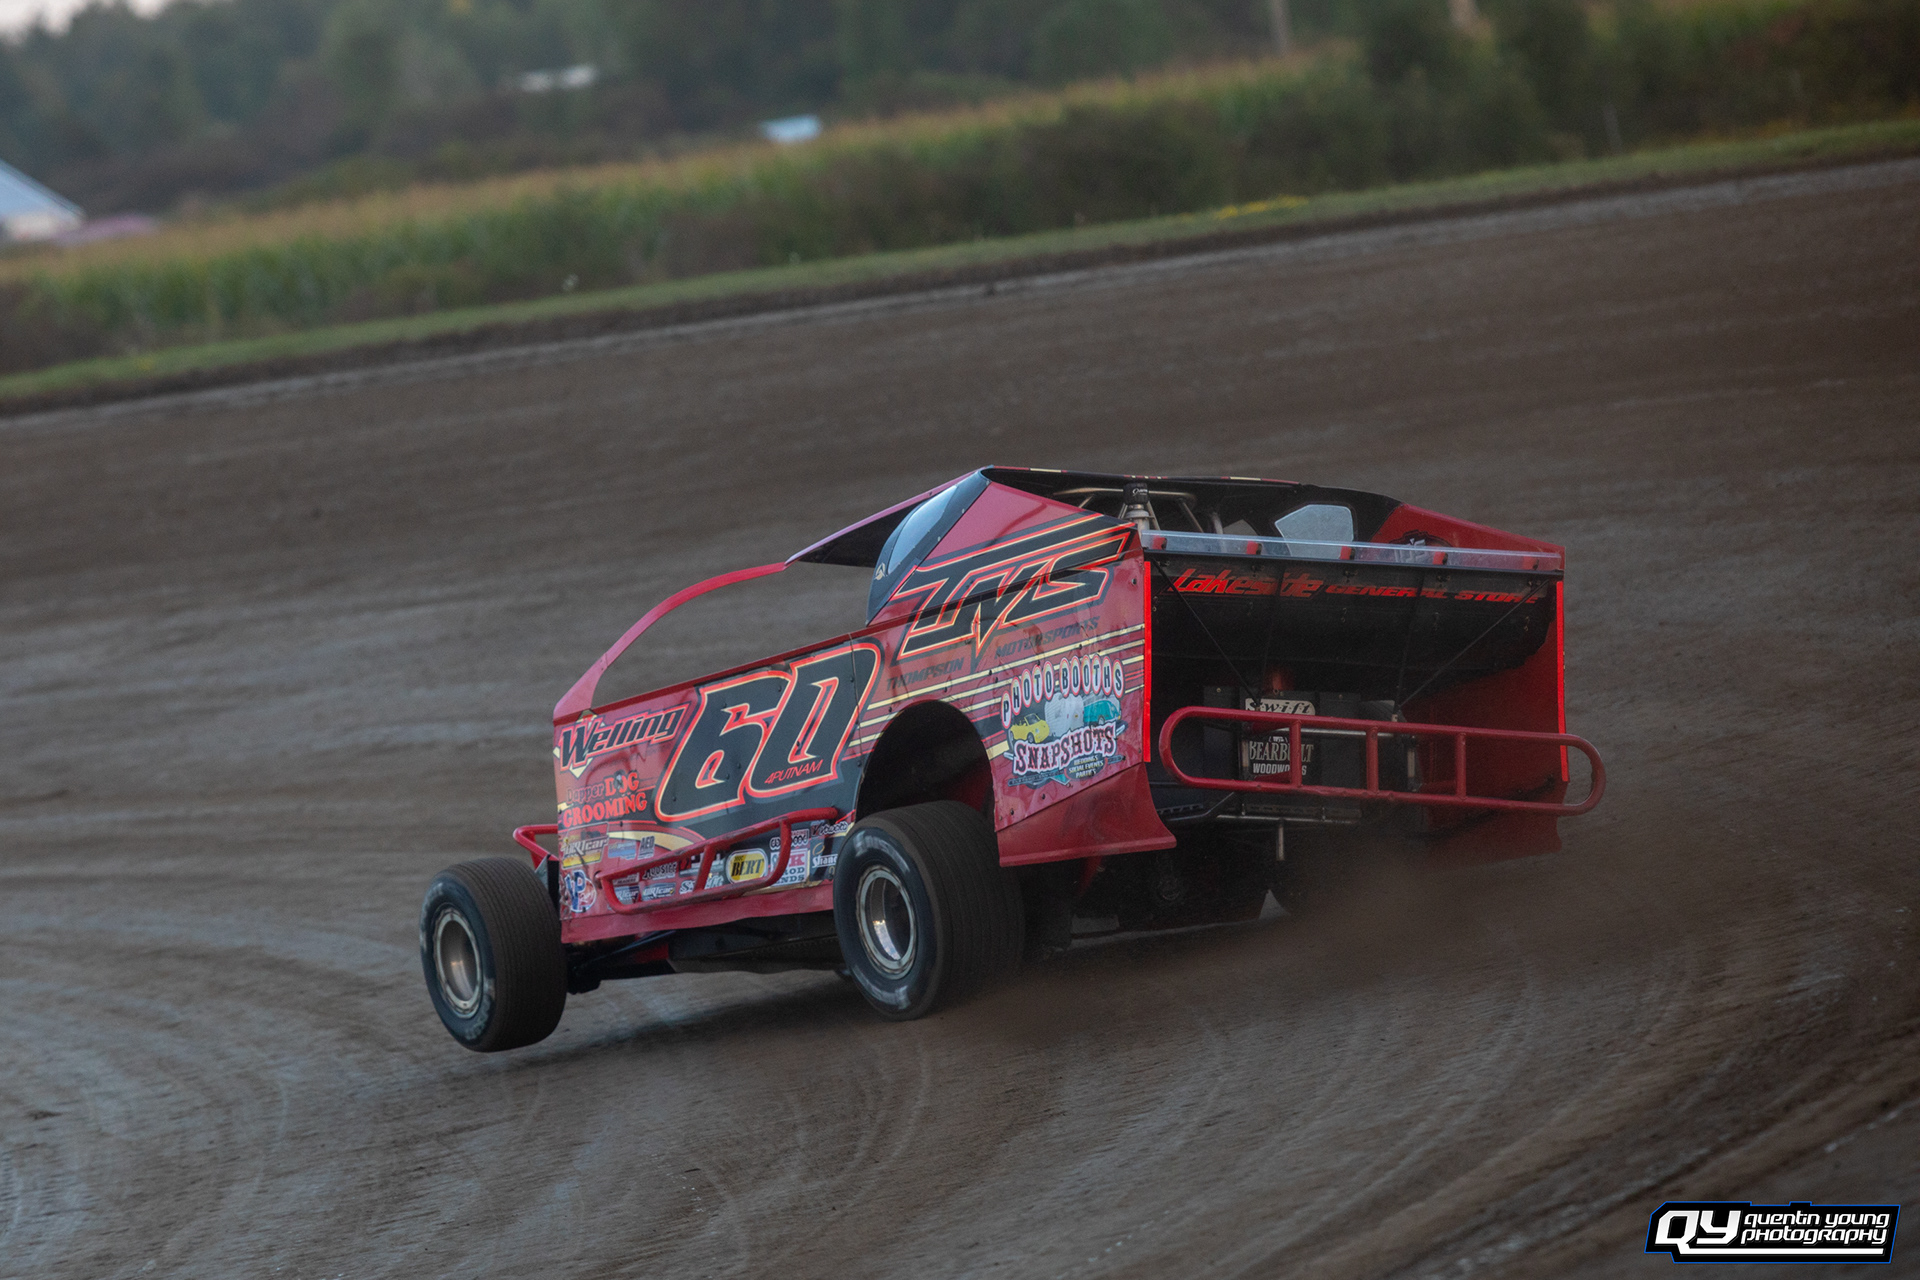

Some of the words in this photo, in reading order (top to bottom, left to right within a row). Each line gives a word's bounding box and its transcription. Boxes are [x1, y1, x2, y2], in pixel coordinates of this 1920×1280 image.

[994, 616, 1099, 660] MOTORSPORTS
[886, 657, 964, 692] THOMPSON
[1002, 665, 1053, 726] PHOTO
[1060, 657, 1124, 698] BOOTHS
[560, 704, 689, 771] Welling
[655, 643, 880, 821] 60
[1014, 725, 1116, 774] SNAPSHOTS
[1249, 740, 1315, 763] BEARBLT
[1253, 762, 1308, 776] WOODWOS
[563, 792, 648, 828] GROOMING
[566, 783, 604, 804] Dapper
[731, 858, 765, 877] BERT
